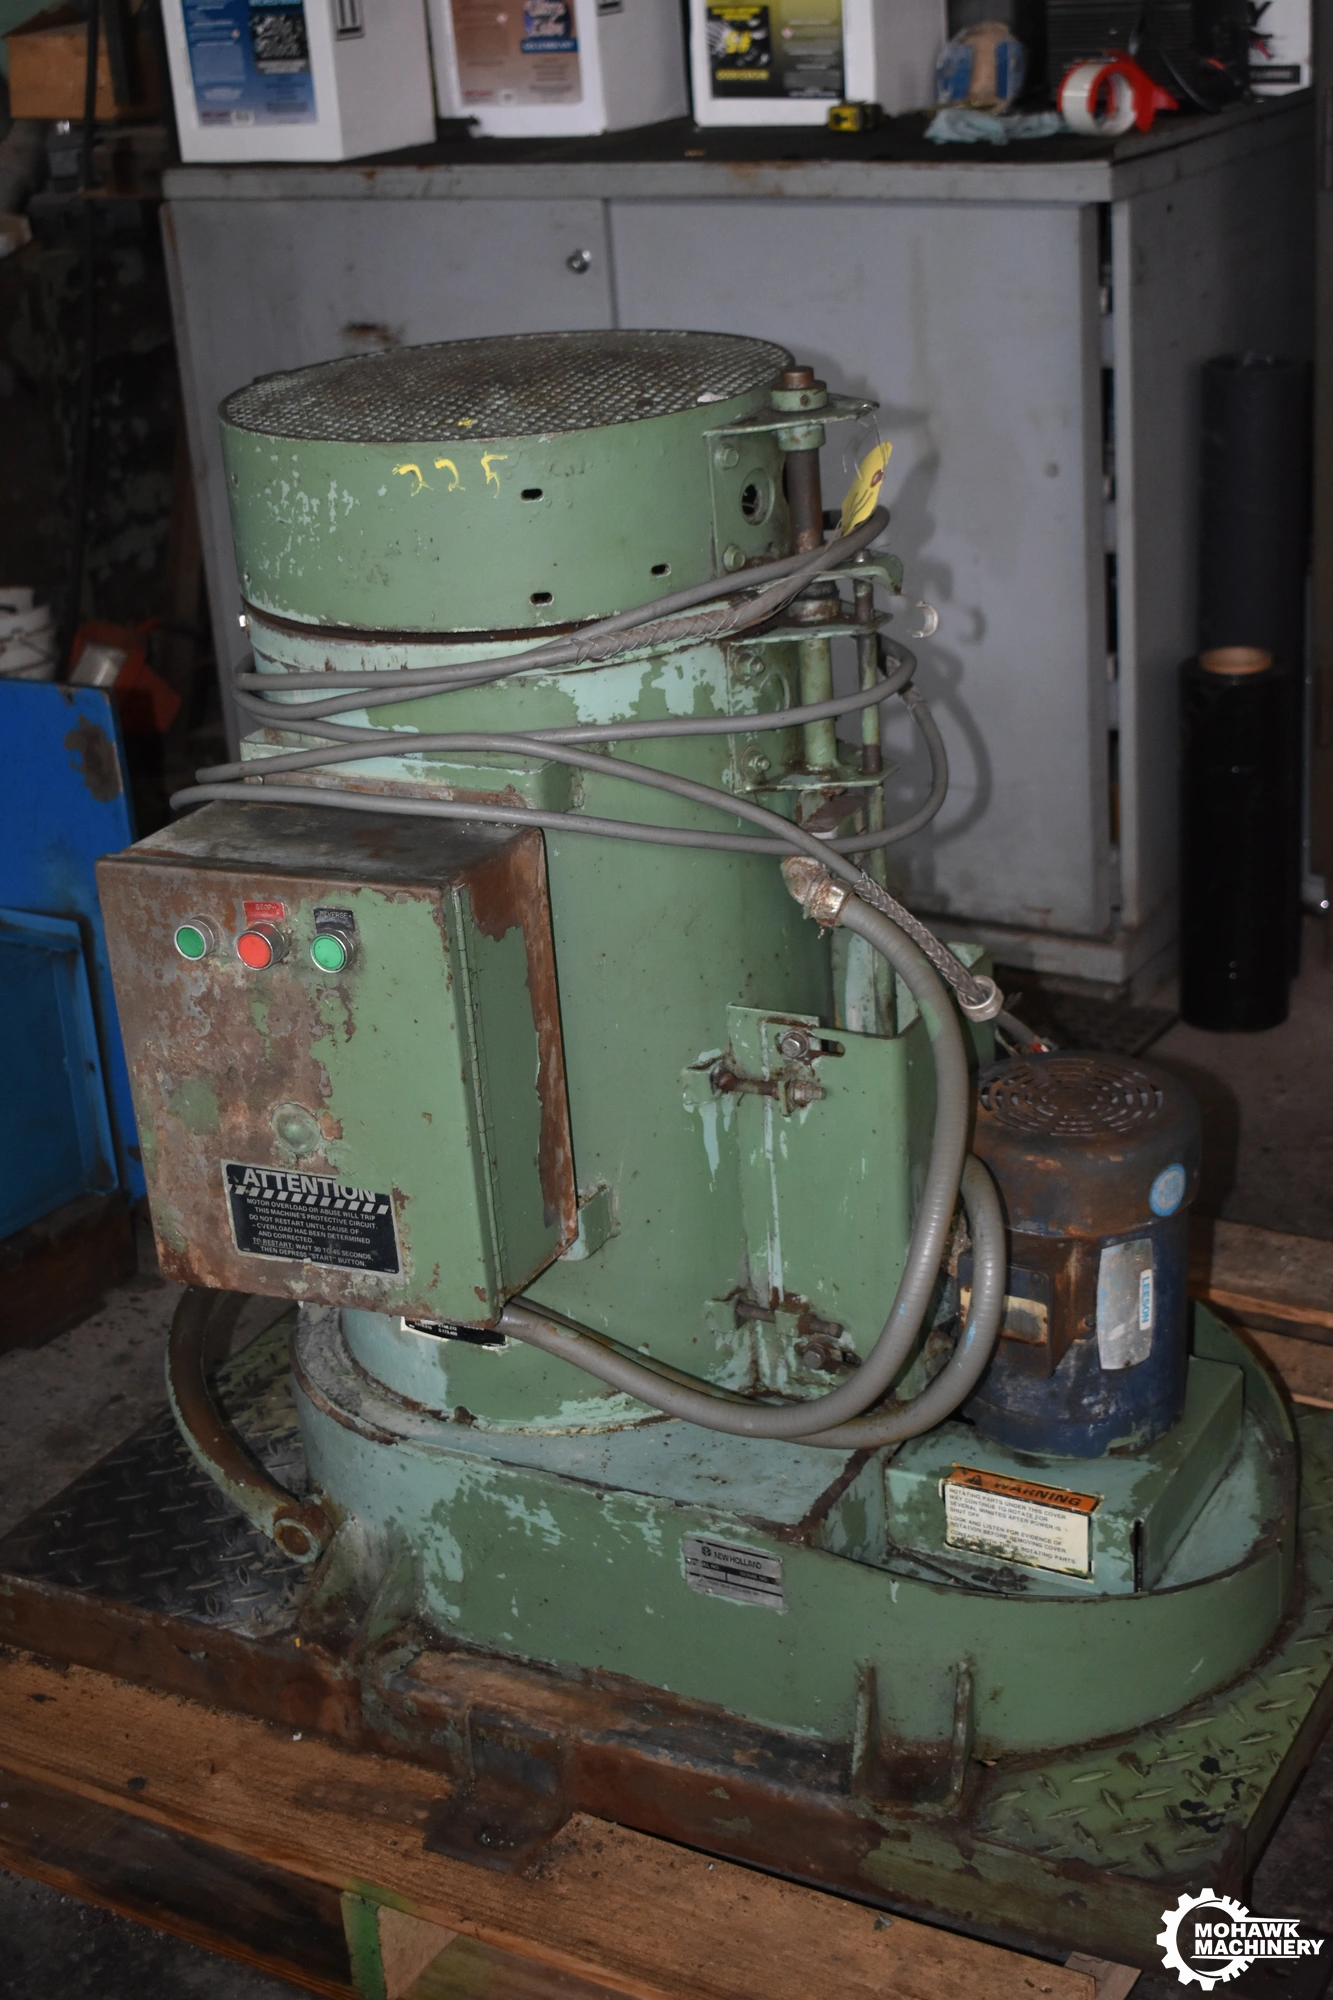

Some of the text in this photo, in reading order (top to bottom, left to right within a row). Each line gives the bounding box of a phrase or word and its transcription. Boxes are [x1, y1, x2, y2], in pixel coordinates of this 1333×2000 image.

[392, 451, 508, 499] 225
[255, 903, 272, 911] STOP
[243, 1168, 376, 1203] ATTENTION
[247, 1198, 270, 1206] MOTOR
[271, 1202, 307, 1212] OVERLOAD
[320, 1208, 344, 1216] ABUSE
[270, 1209, 306, 1219] MACHINE'S
[307, 1214, 348, 1225] PROTECTIVE
[349, 1220, 378, 1230] CIRCUIT.
[275, 1217, 304, 1227] RESTART
[306, 1222, 326, 1230] UNTIL
[327, 1225, 349, 1233] CAUSE
[257, 1223, 292, 1233] OVERLOAD
[309, 1230, 326, 1238] BEEN
[328, 1232, 370, 1244] DETERMINED
[273, 1233, 314, 1243] CORRECTED.
[261, 1246, 278, 1254] THEN
[279, 1249, 307, 1258] DEPRESS
[338, 1257, 366, 1267] BUTTON.
[1142, 1276, 1150, 1323] LEESON
[949, 1488, 980, 1499] ROTATING
[982, 1496, 1003, 1505] PARTS
[1005, 1501, 1026, 1510] UNDER
[1044, 1511, 1066, 1520] COVER
[994, 1482, 1082, 1506] WARNING
[950, 1507, 966, 1515] SHUT
[950, 1501, 977, 1511] SEVERAL
[979, 1508, 1006, 1519] MINUTES
[1008, 1514, 1028, 1524] AFTER
[1030, 1520, 1053, 1529] POWER
[964, 1498, 995, 1510] CONTINUE
[1008, 1508, 1034, 1519] ROTATE
[950, 1516, 966, 1524] LOOK
[983, 1524, 1004, 1533] LISTEN
[1021, 1531, 1051, 1544] EVIDENCE
[950, 1522, 981, 1533] ROTATION
[983, 1530, 1008, 1540] BEFORE
[1009, 1536, 1042, 1548] REMOVING
[714, 1552, 762, 1569] NEW HOLLAND
[1000, 1541, 1019, 1551] THESE
[1021, 1548, 1053, 1559] ROTATING
[1054, 1555, 1076, 1564] PARTS
